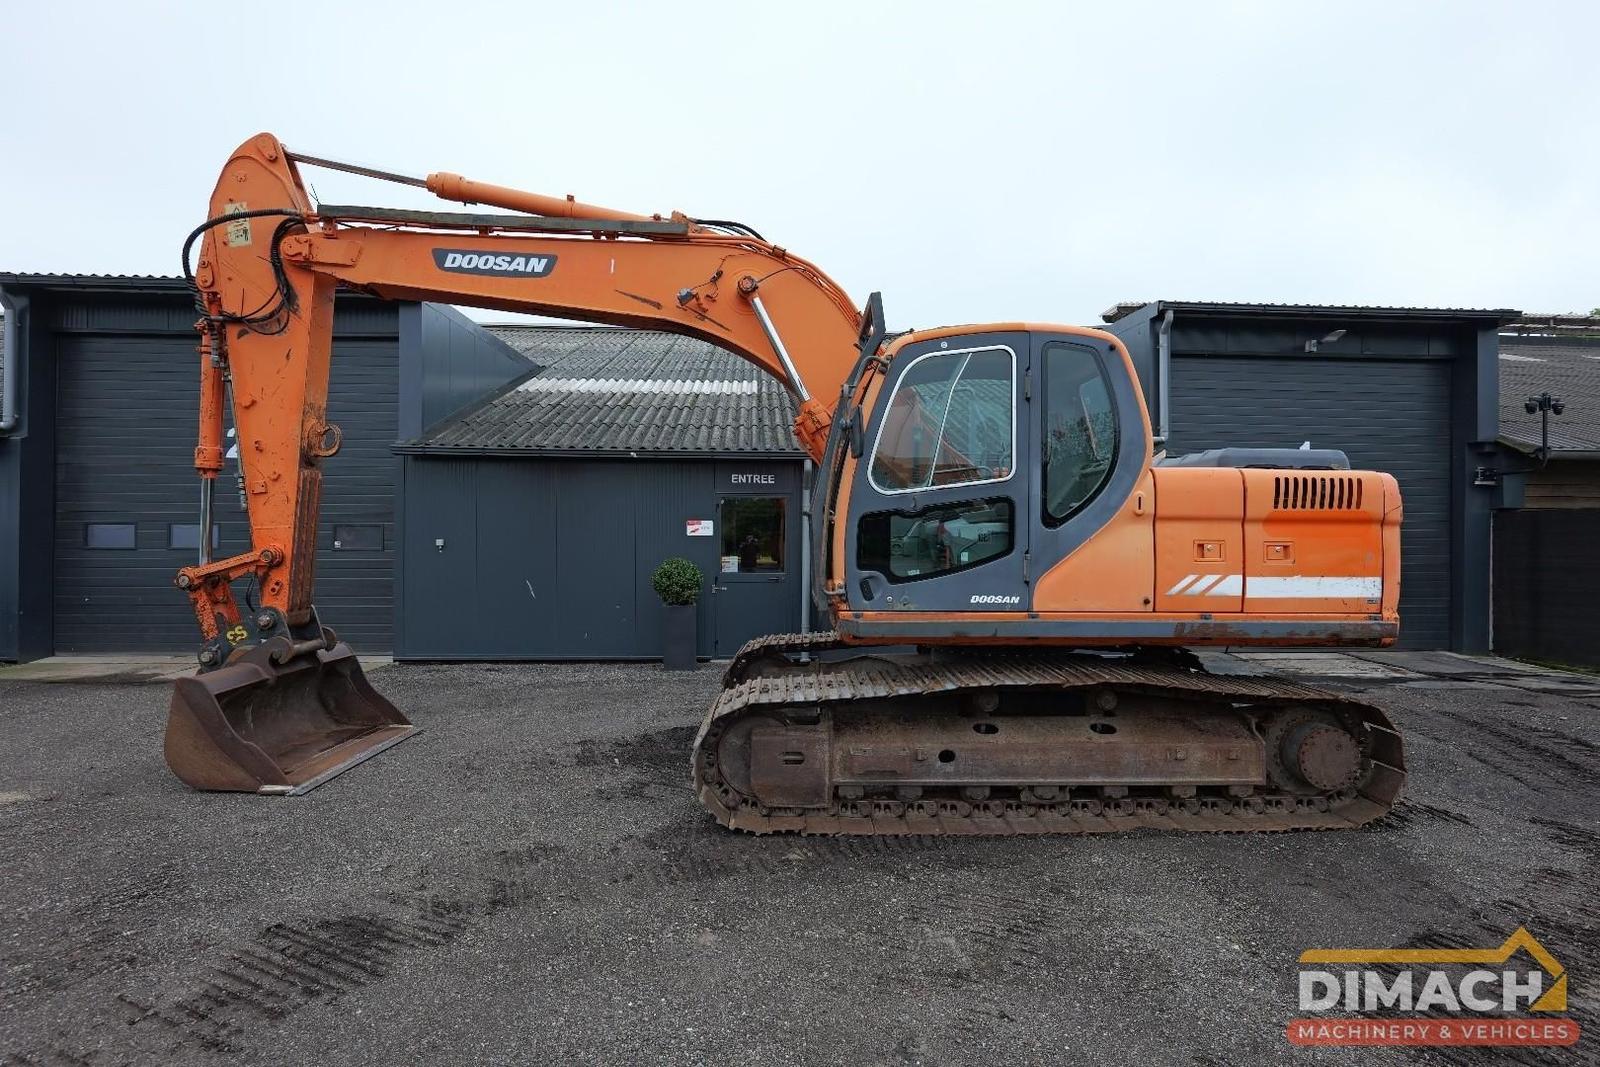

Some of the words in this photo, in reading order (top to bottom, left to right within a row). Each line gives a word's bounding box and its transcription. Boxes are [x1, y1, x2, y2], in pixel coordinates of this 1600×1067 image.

[443, 252, 548, 273] DOOSAN
[731, 474, 776, 484] ENTREE
[970, 595, 1020, 604] DOOSAN
